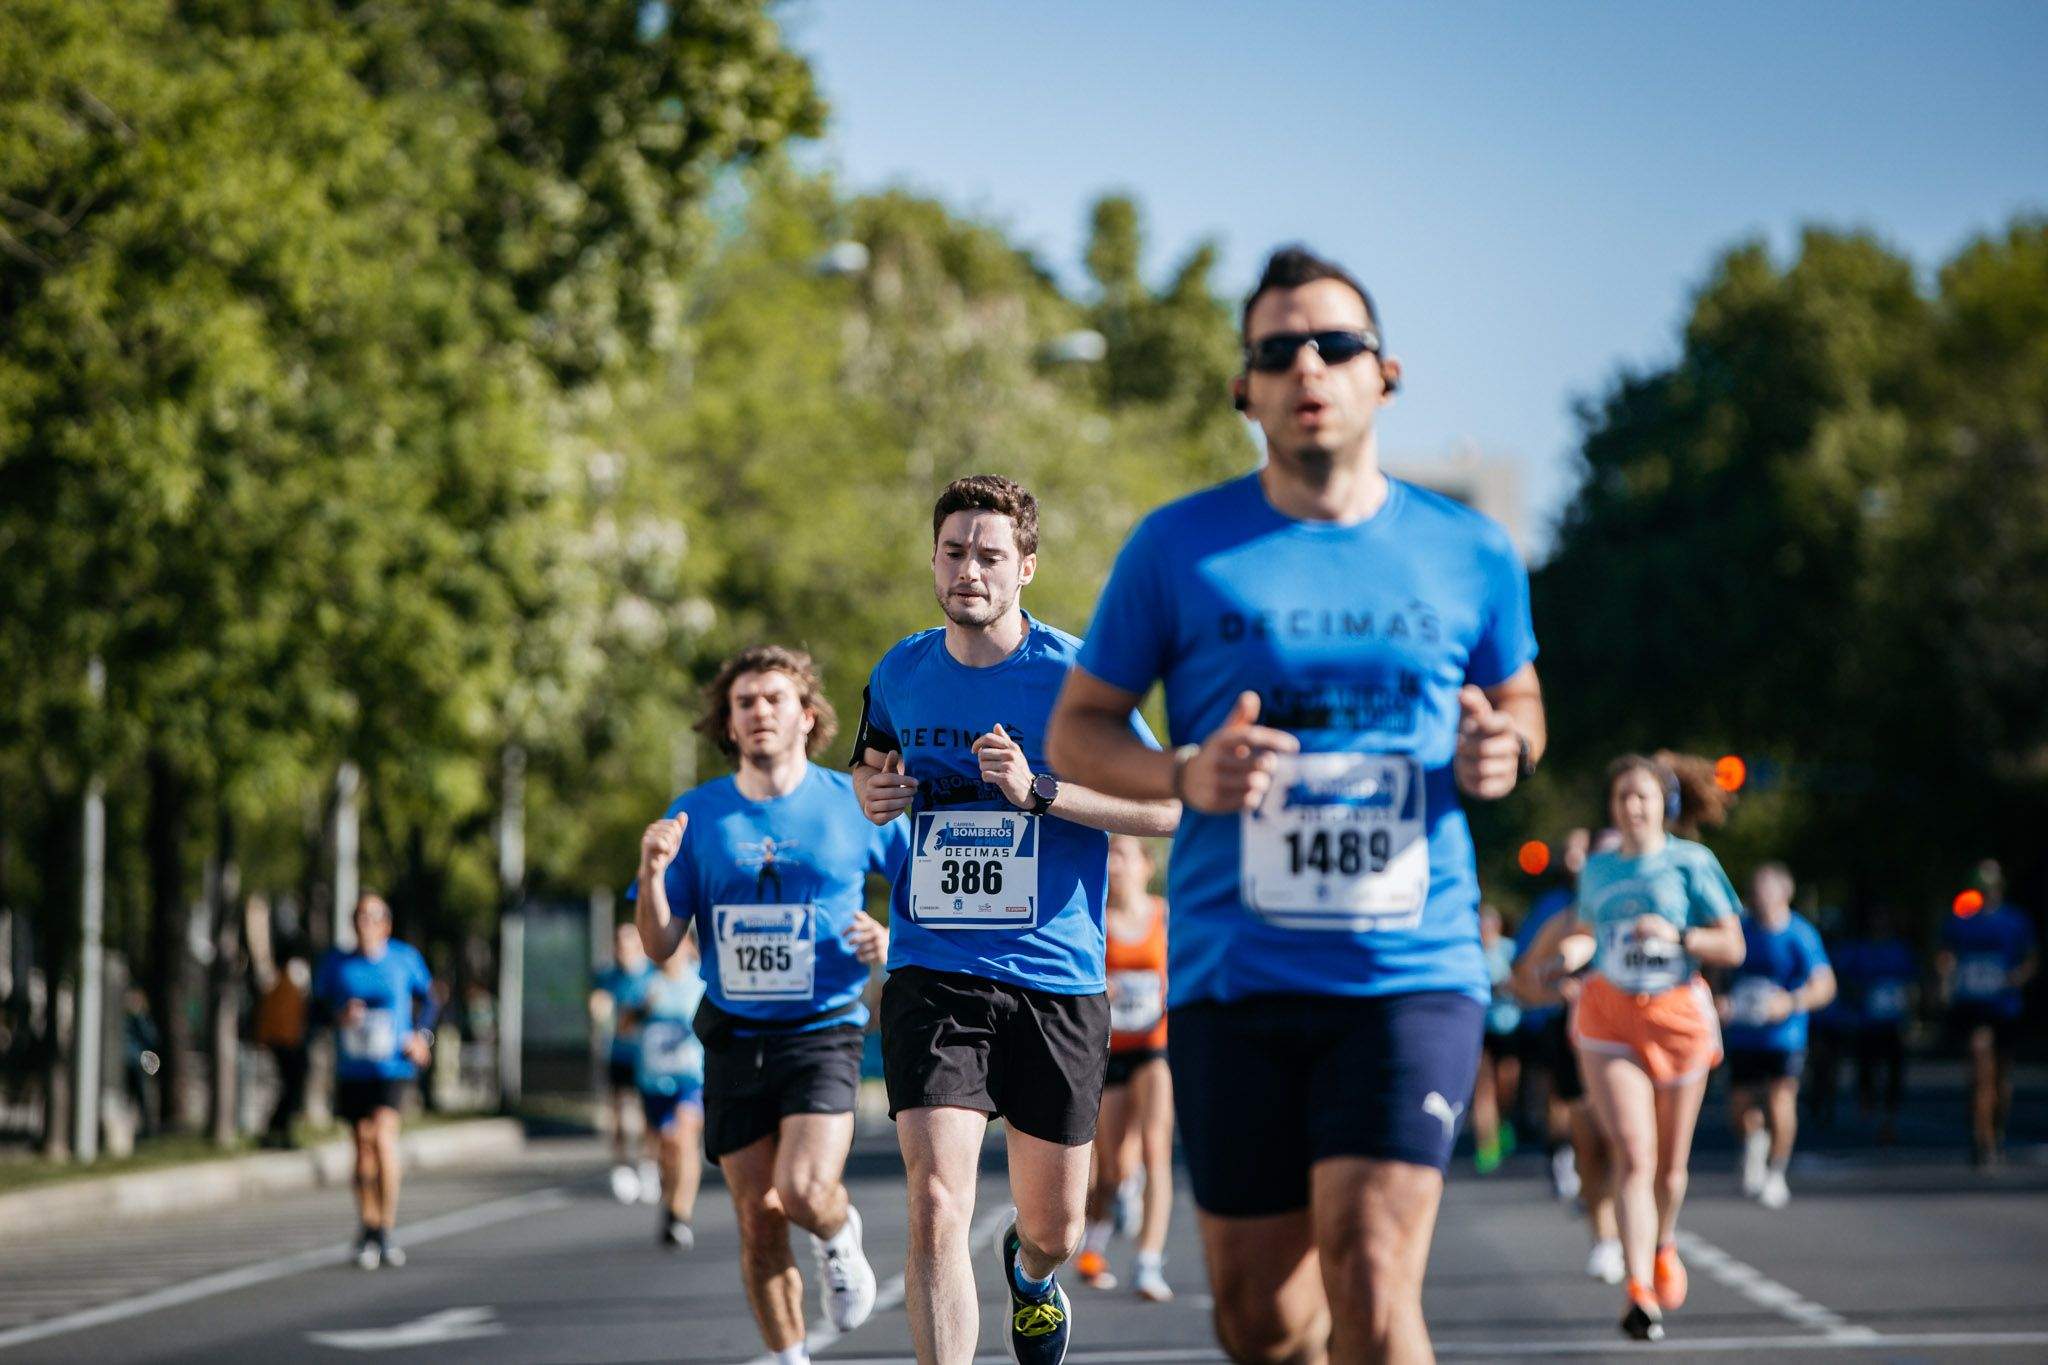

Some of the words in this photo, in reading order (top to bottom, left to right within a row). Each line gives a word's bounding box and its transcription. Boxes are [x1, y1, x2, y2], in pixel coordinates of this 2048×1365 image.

[1219, 610, 1441, 643] DECIMAS
[953, 828, 1012, 837] BOMBEROS
[945, 847, 1010, 857] DECIMAS
[1284, 828, 1391, 875] 1489
[941, 860, 1003, 895] 386
[735, 946, 791, 972] 1265
